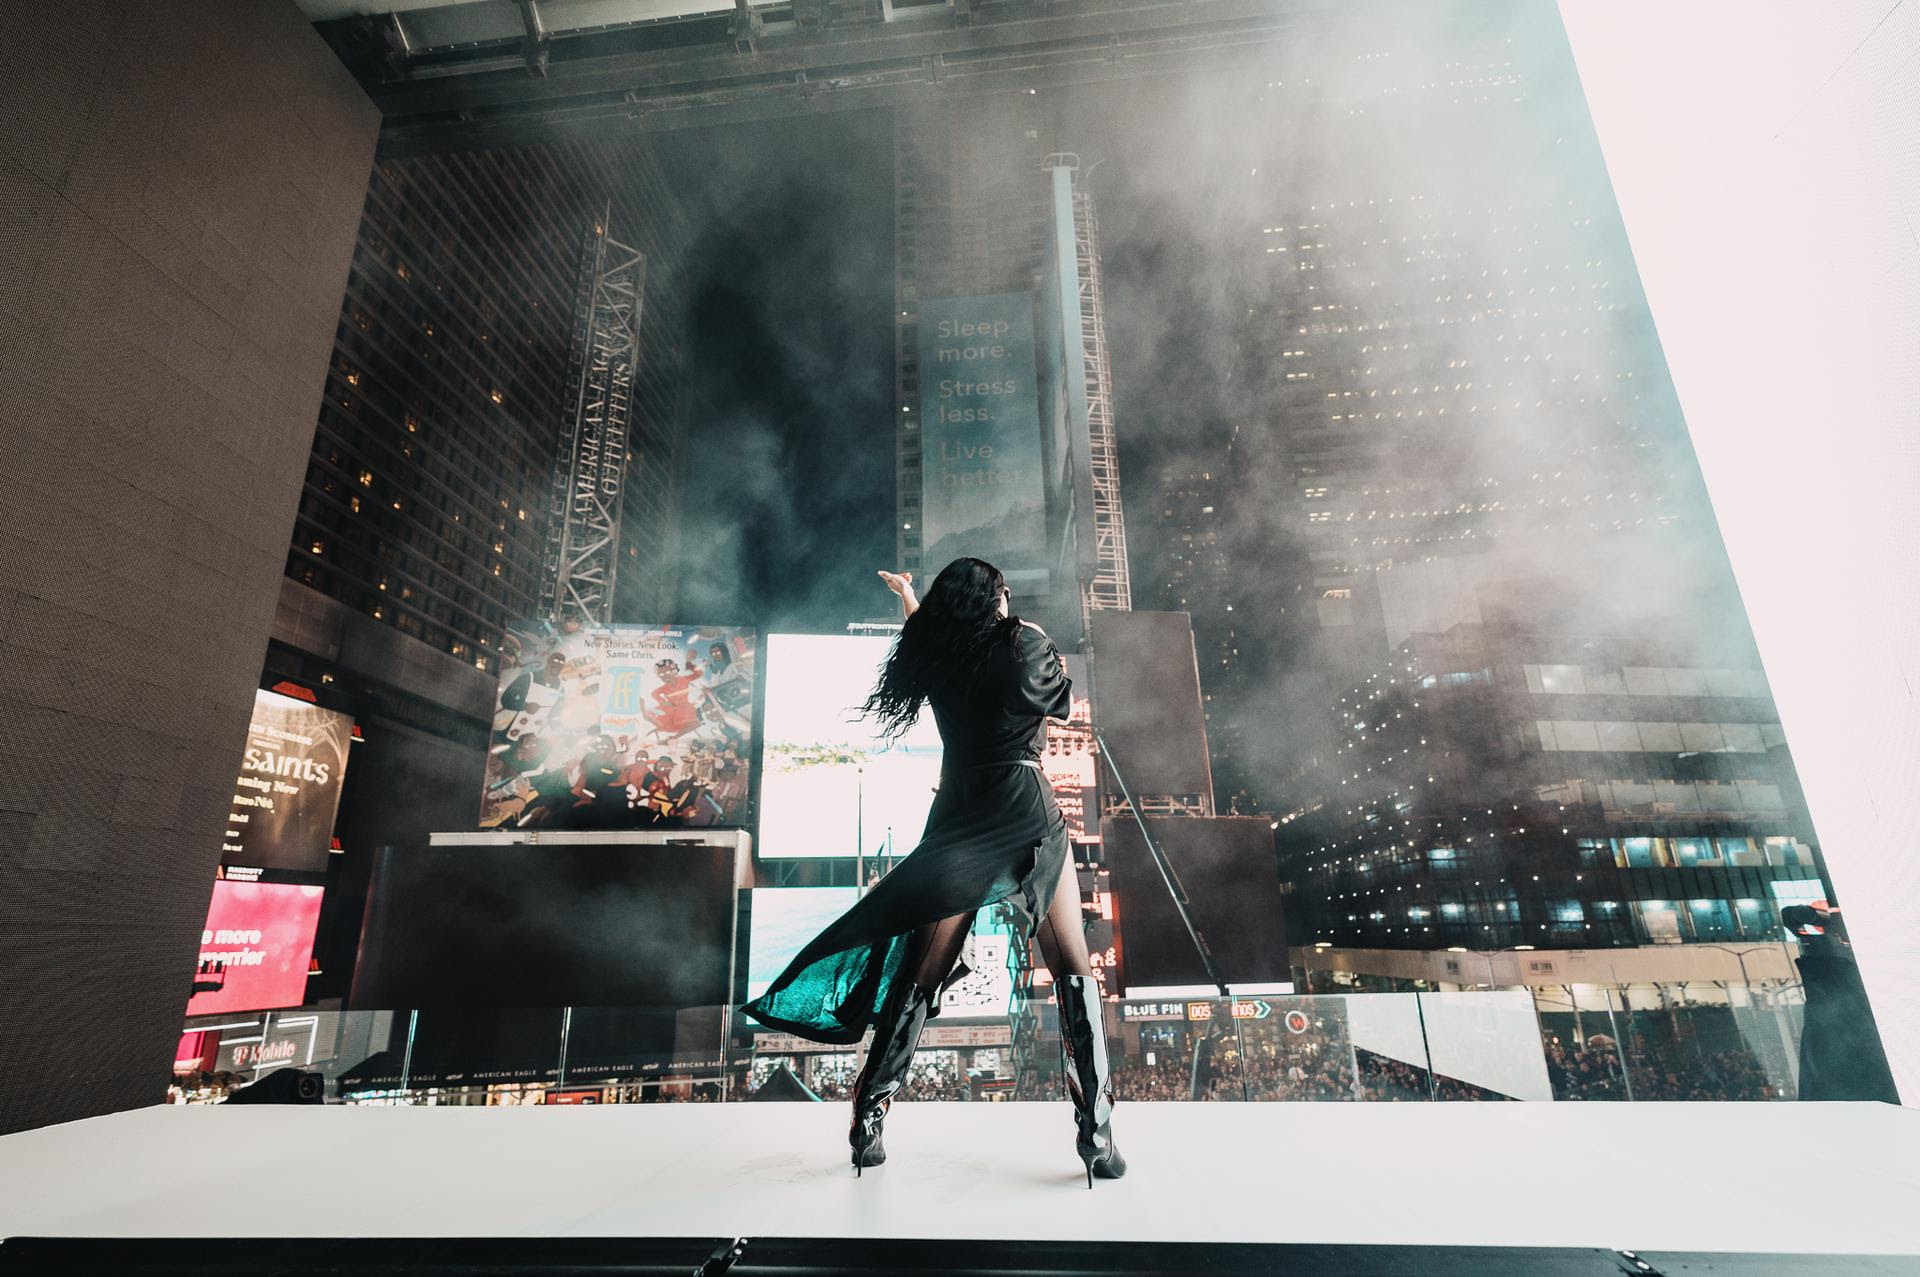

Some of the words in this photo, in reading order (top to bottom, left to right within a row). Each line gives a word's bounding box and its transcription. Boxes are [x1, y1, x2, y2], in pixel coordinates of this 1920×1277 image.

[938, 320, 1009, 338] Sleep
[938, 345, 1012, 362] more.
[939, 380, 1017, 399] Stress
[939, 404, 996, 424] less.
[941, 439, 993, 461] Live
[584, 640, 602, 648] New
[638, 641, 655, 649] New
[606, 650, 630, 658] Same
[215, 930, 262, 945] more
[1124, 1003, 1158, 1016] BLUE
[1161, 1002, 1184, 1015] FIN
[1190, 1005, 1211, 1018] DOS
